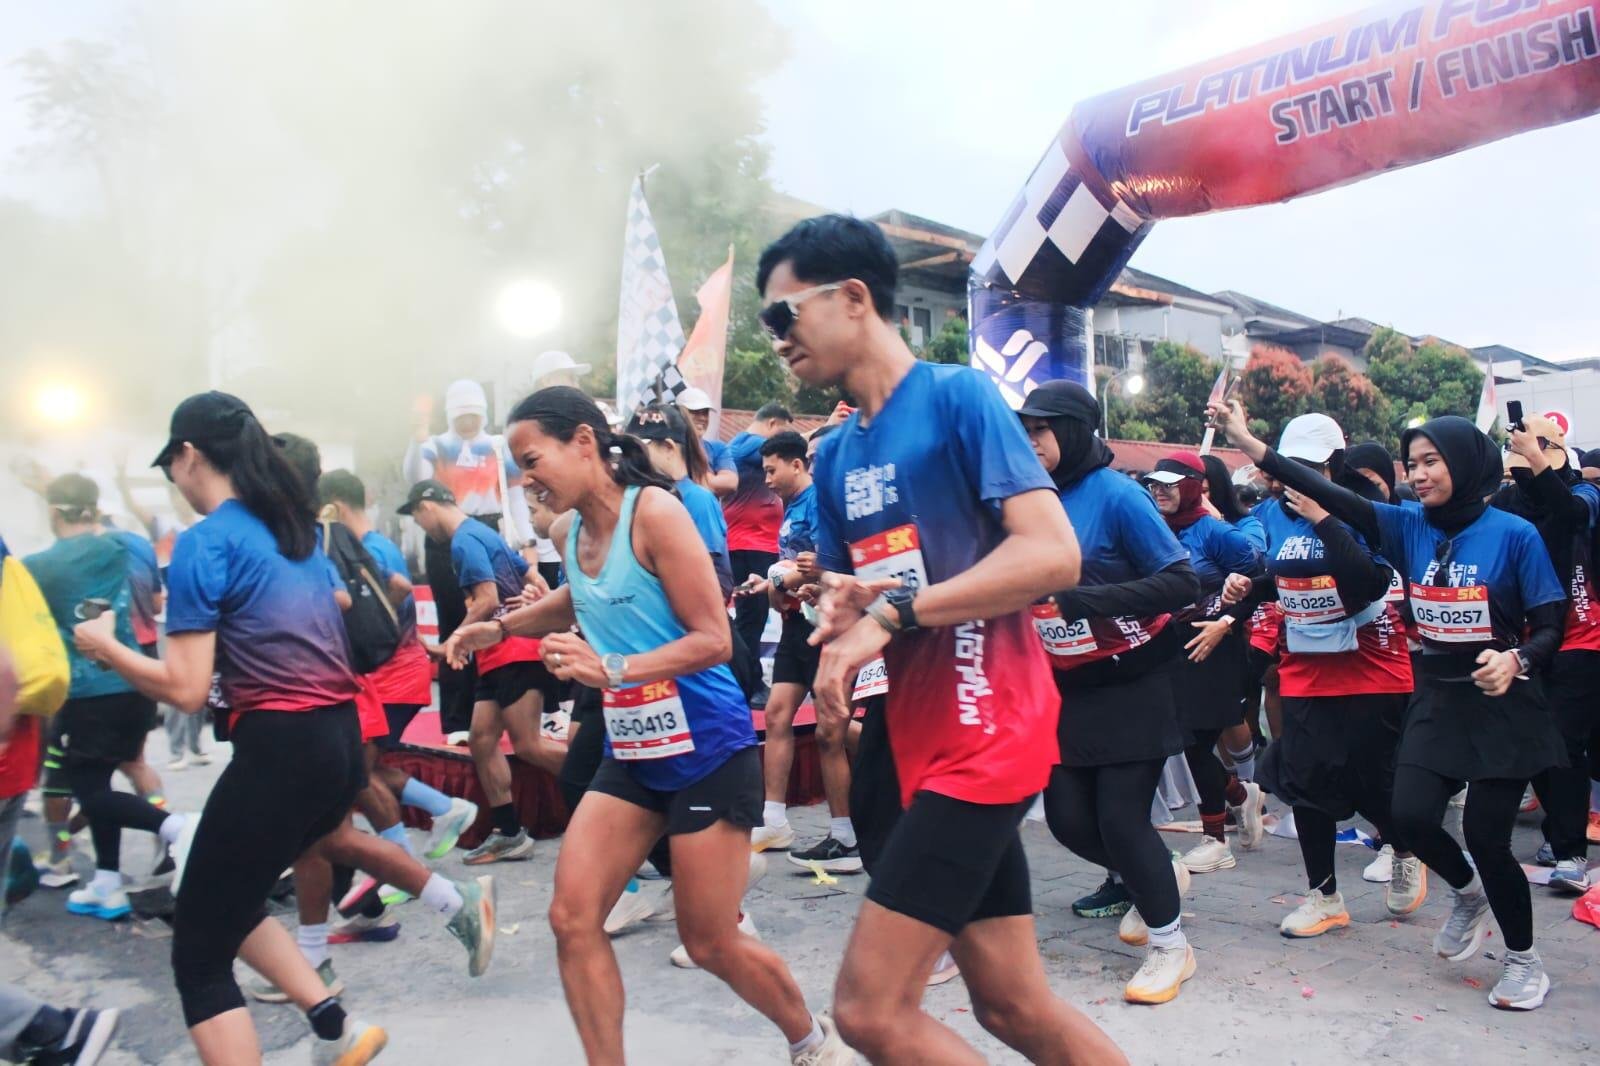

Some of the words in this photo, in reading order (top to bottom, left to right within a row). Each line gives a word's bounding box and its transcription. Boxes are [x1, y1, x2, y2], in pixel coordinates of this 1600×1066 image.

[1126, 8, 1426, 137] PLATINUM
[1270, 70, 1396, 146] START
[1409, 60, 1425, 112] /
[1434, 6, 1599, 97] FINISH
[1311, 576, 1333, 589] 5K
[1283, 596, 1336, 610] 05-0225
[1457, 587, 1483, 600] 5K
[1416, 607, 1483, 624] 05-0257
[642, 679, 673, 702] 5K
[610, 711, 678, 737] 05-0413
